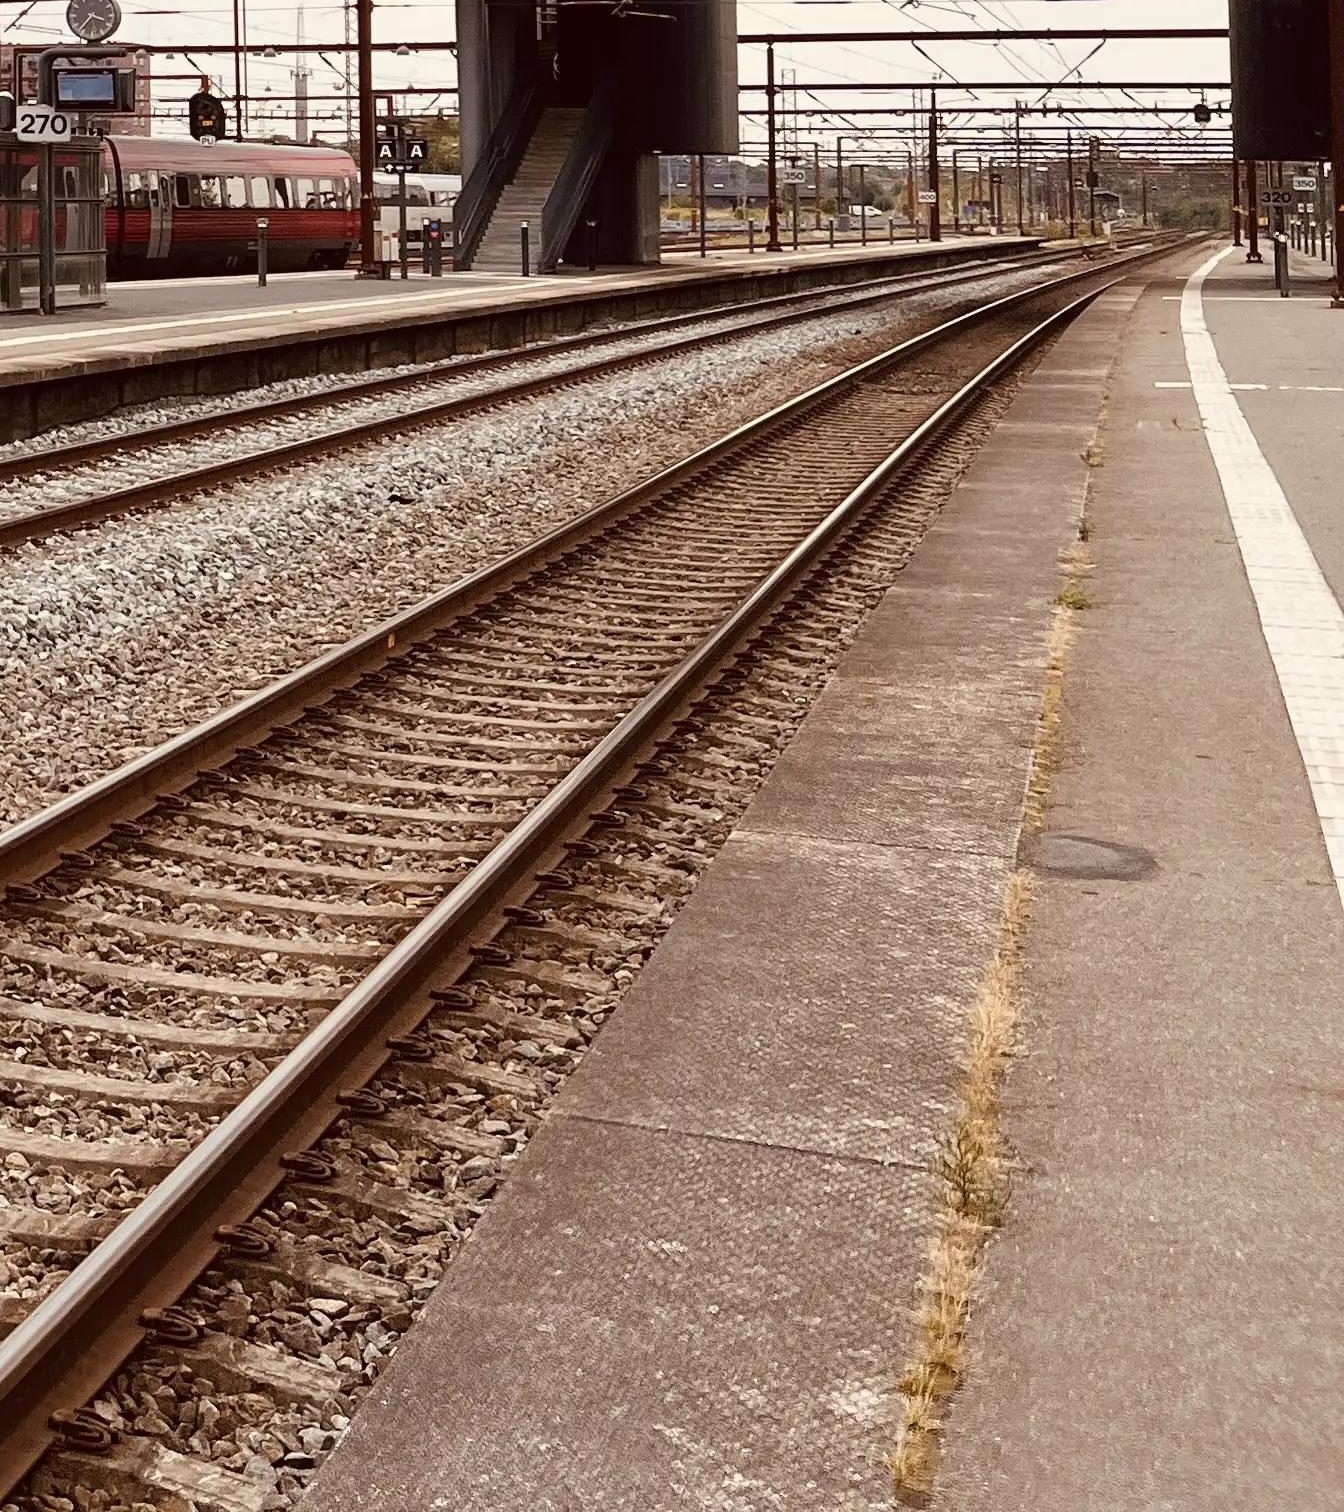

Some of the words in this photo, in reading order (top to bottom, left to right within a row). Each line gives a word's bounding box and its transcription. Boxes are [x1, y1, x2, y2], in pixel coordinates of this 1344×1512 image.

[20, 113, 68, 135] 270
[379, 144, 392, 158] A
[410, 144, 423, 158] A
[783, 171, 805, 181] 350
[1294, 180, 1316, 188] 350
[1260, 191, 1292, 203] 320
